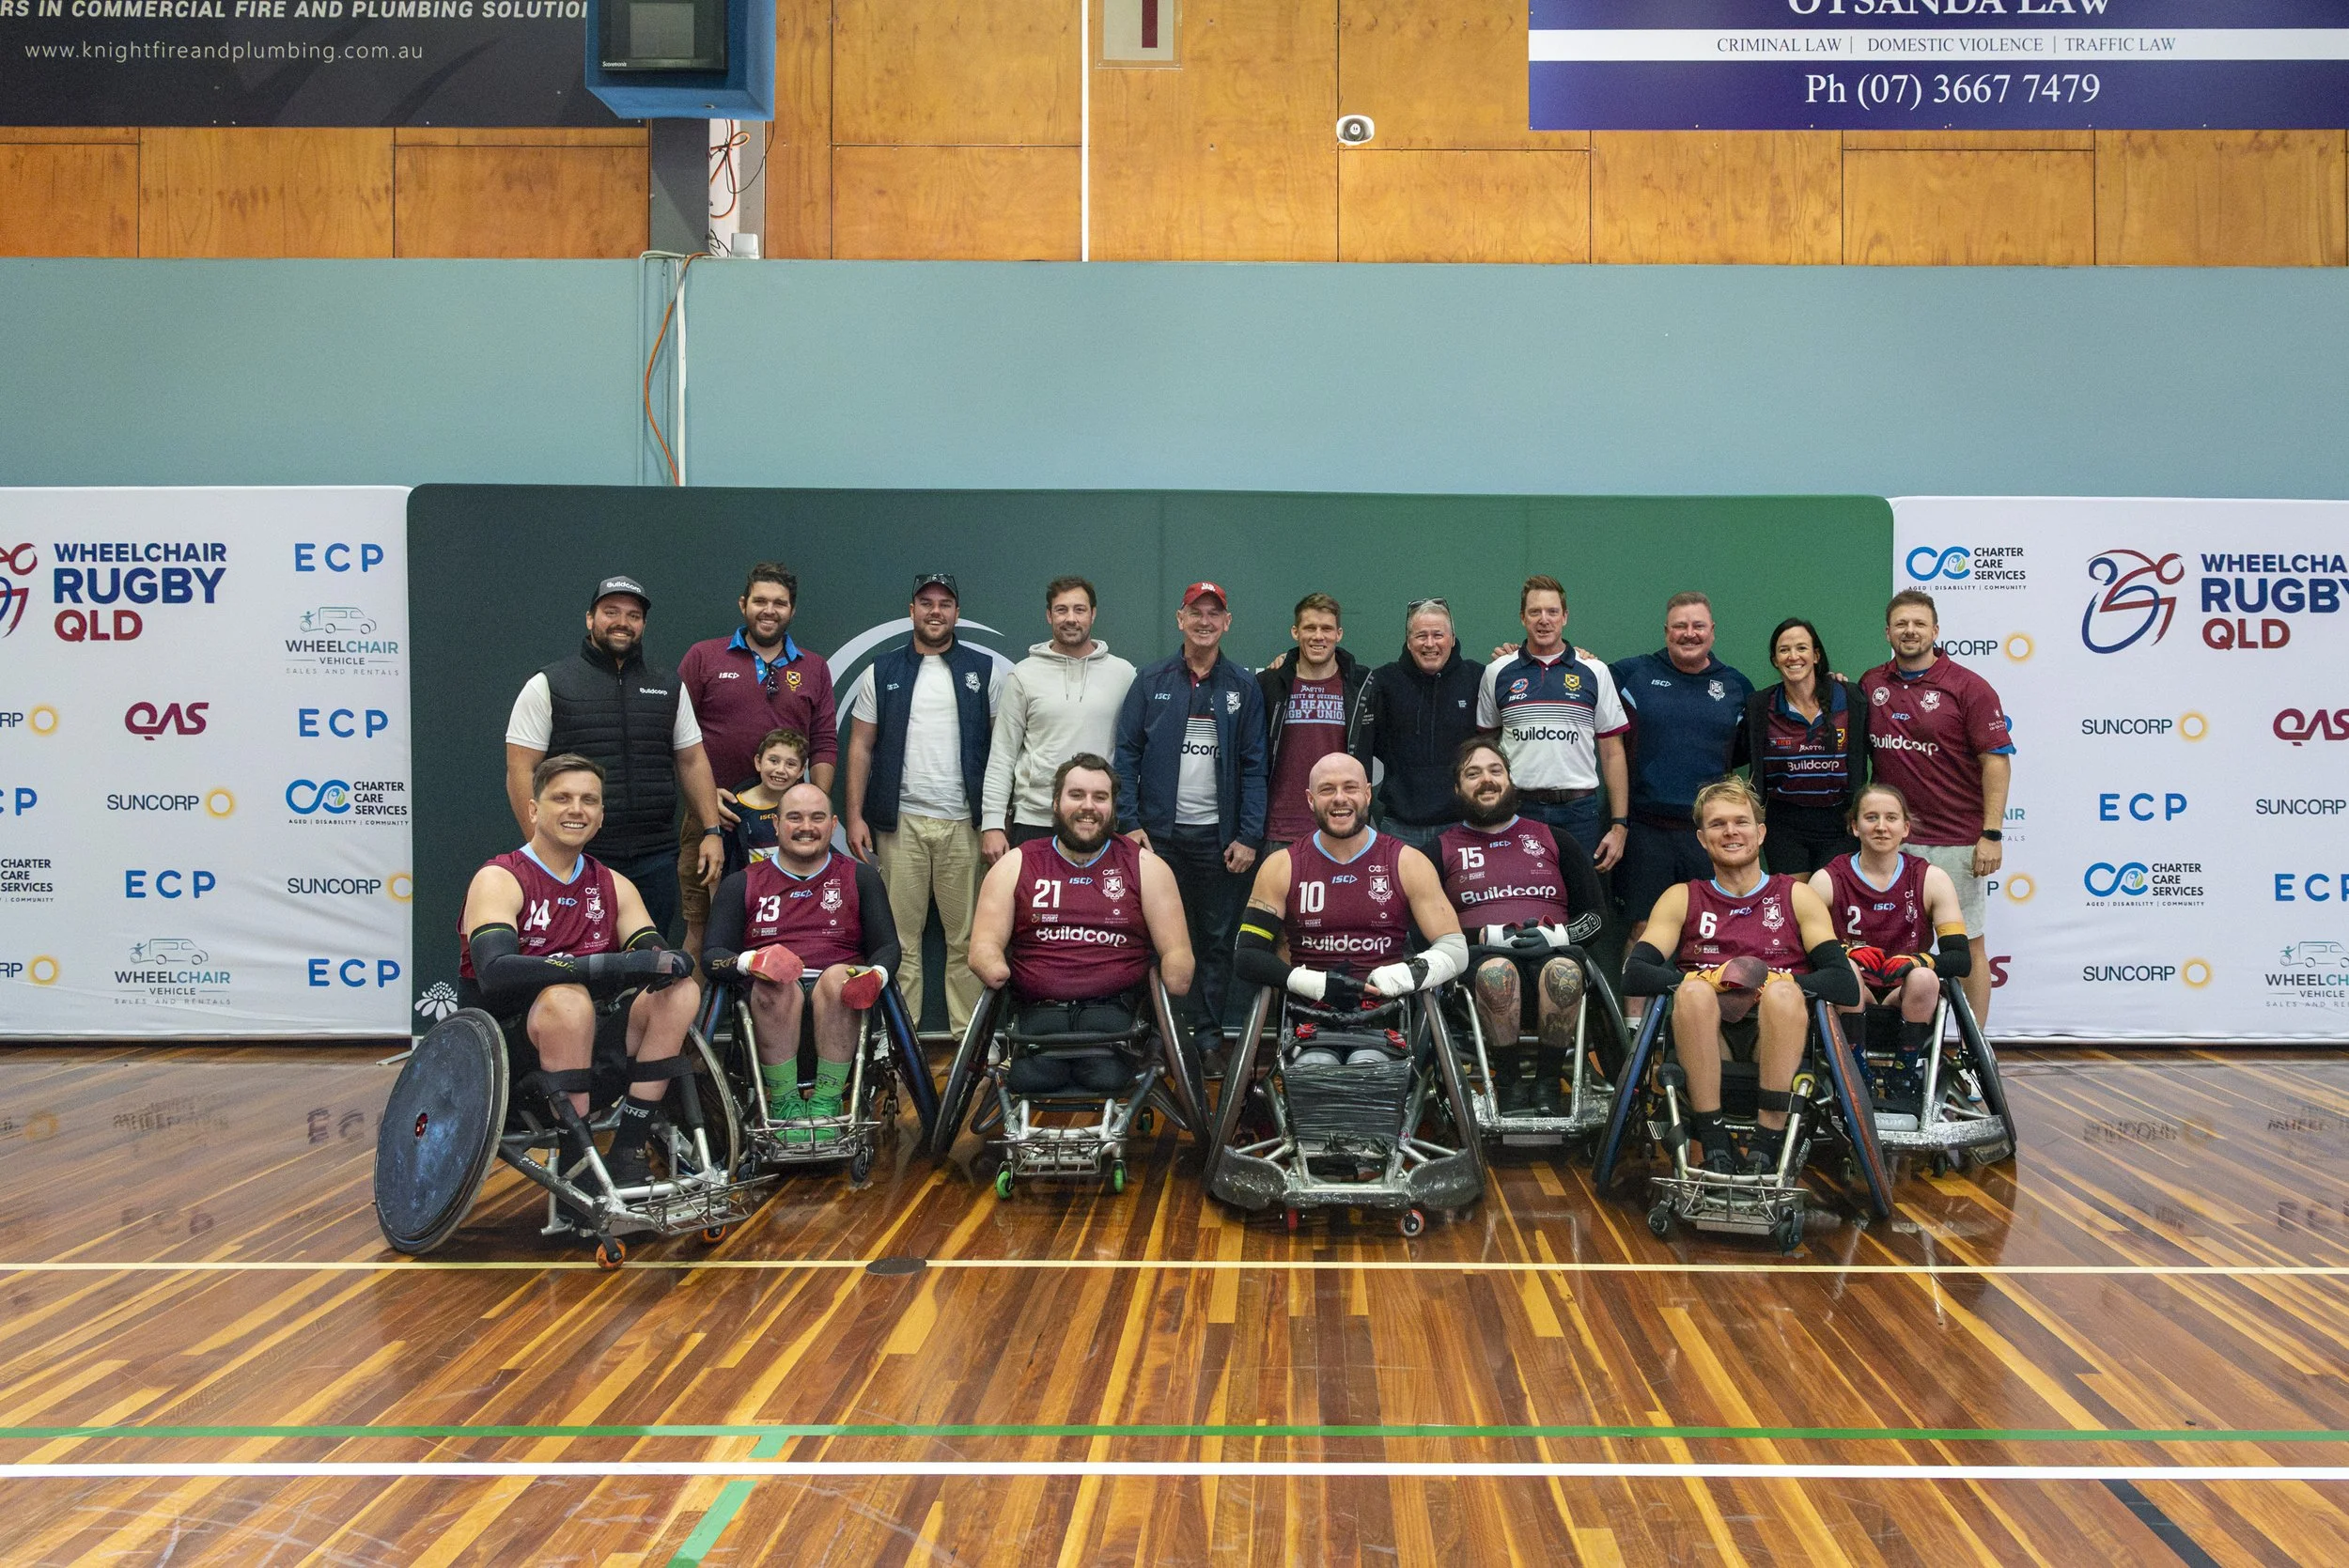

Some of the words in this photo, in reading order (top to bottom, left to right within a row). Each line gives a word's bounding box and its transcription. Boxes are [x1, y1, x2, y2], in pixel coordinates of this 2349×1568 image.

[38, 0, 62, 18] IN
[71, 0, 226, 18] COMMERCIAL
[235, 0, 286, 18] FIRE
[293, 0, 343, 18] AND
[351, 0, 474, 18] PLUMBING
[25, 40, 423, 63] www.knightfireandplumbing.com.au
[1717, 38, 1801, 52] CRIMINAL
[1806, 38, 1842, 52] LAW
[1867, 38, 1954, 52] DOMESTIC
[1959, 38, 2044, 52] VIOLENCE
[2064, 38, 2135, 52] TRAFFIC
[2139, 38, 2176, 52] LAW
[1805, 73, 1847, 102] Ph
[1858, 73, 1921, 110] (07)
[1933, 73, 2011, 102] 3667
[2023, 73, 2101, 102] 7479
[54, 542, 226, 562] WHEELCHAIR
[294, 542, 384, 573] ECP
[1974, 547, 2024, 557] CHARTER
[1974, 559, 2003, 568] CARE
[2201, 553, 2348, 573] WHEELCHA
[1974, 570, 2026, 581] SERVICES
[54, 567, 226, 605] RUGBY
[606, 581, 642, 593] Buildcorp
[54, 609, 143, 643] QLD
[2201, 617, 2291, 651] QLD
[285, 640, 399, 654] WHEELCHAIR
[1932, 641, 1999, 657] NCORP
[319, 657, 366, 665] VEHICLE
[639, 687, 668, 696] Buildcorp
[124, 701, 210, 740] QAS
[299, 707, 388, 738] ECP
[1285, 709, 1313, 720] GBY
[1513, 726, 1579, 744] Buildcorp
[2081, 719, 2172, 735] SUNCORP
[1869, 733, 1939, 755] Buildcorp
[1786, 759, 1839, 771] Buildcorp
[353, 781, 405, 792] CHARTER
[0, 787, 38, 815] P
[106, 794, 199, 811] SUNCORP
[354, 793, 383, 803] CARE
[2099, 792, 2187, 821] ECP
[2255, 798, 2346, 815] SUNCORP
[354, 805, 408, 815] SERVICES
[1, 859, 52, 869] CHARTER
[1457, 846, 1485, 870] 15
[1, 870, 30, 880] CARE
[2152, 862, 2202, 873] CHARTER
[1, 882, 54, 892] SERVICES
[125, 870, 216, 899] ECP
[287, 877, 381, 895] SUNCORP
[2152, 875, 2181, 885] CARE
[1032, 878, 1061, 908] 21
[1299, 880, 1325, 913] 10
[1461, 884, 1557, 905] Buildcorp
[2153, 886, 2204, 896] SERVICES
[523, 898, 552, 931] 14
[755, 894, 781, 923] 13
[1699, 910, 1718, 939] 6
[1847, 905, 1861, 936] 2
[1035, 924, 1128, 947] Buildcorp
[1301, 934, 1392, 955] Buildcorp
[115, 970, 230, 984] WHEELCHAIR
[309, 958, 400, 988] ECP
[2082, 965, 2175, 982] SUNCORP
[149, 987, 196, 996] VEHICLE
